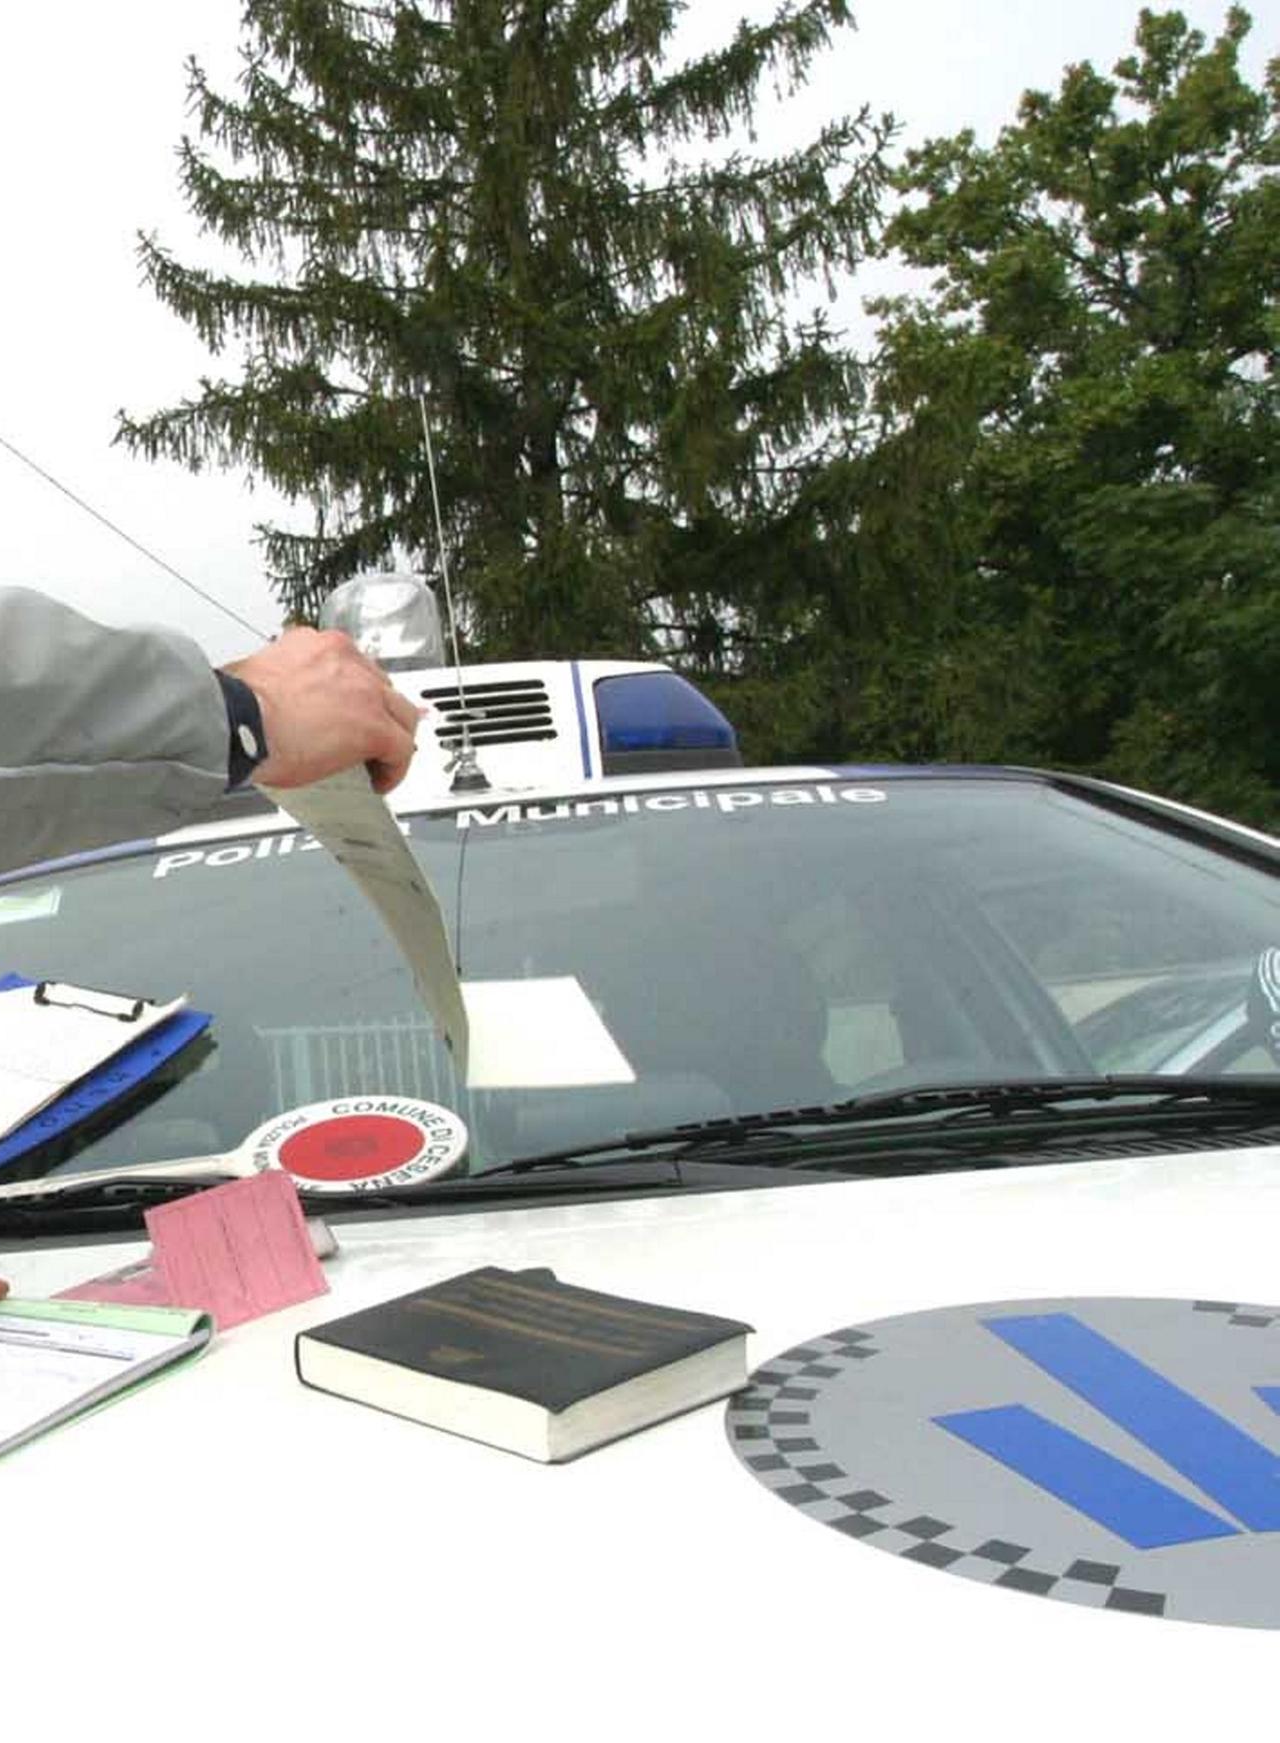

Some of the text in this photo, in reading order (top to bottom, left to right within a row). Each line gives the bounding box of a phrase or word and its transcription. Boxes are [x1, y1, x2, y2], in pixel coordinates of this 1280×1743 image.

[456, 785, 887, 828] Municipale
[332, 1101, 446, 1128] COMUNE
[430, 1128, 454, 1142] DI
[349, 1144, 450, 1191] CESENA
